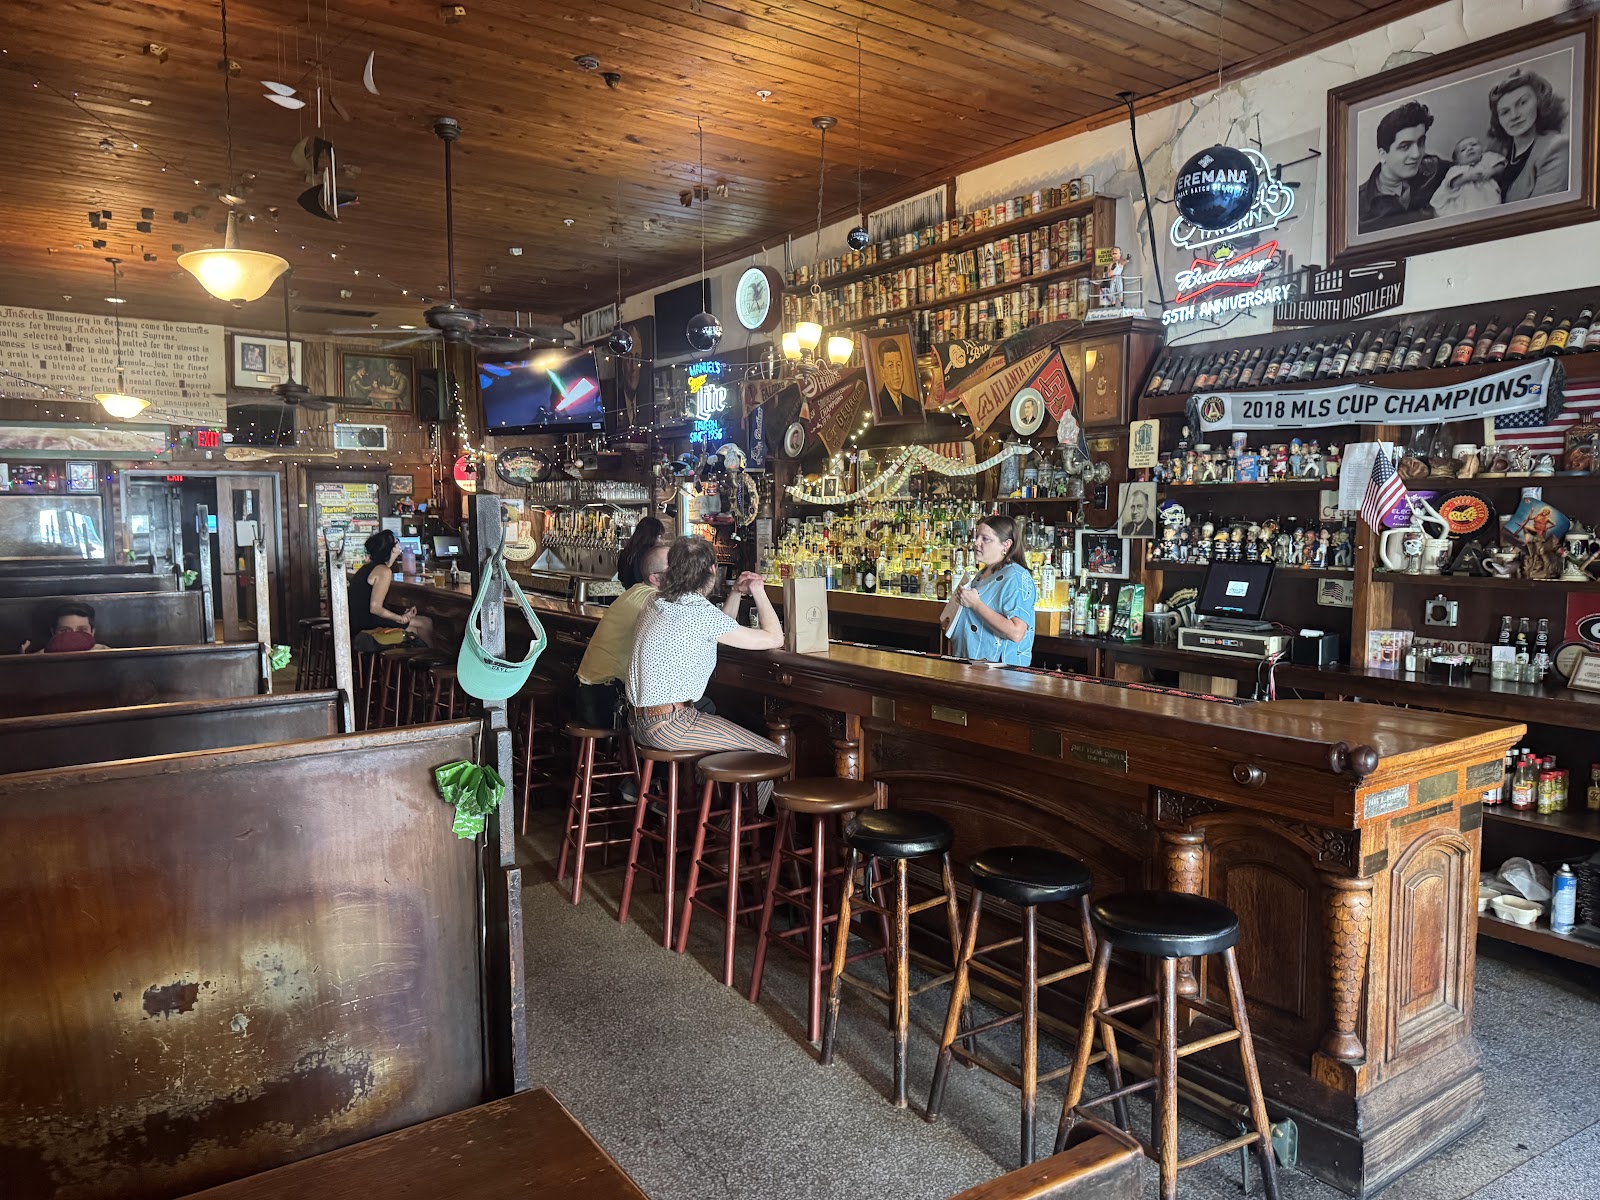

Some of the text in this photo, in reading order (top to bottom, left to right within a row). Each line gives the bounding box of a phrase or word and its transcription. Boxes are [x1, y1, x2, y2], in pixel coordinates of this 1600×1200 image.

[1177, 168, 1249, 190] EREMANA
[1175, 258, 1273, 291] Budweiser
[1161, 283, 1292, 326] 55TH ANNIVERSARY
[1276, 282, 1402, 321] OLD FOURTH DISTILLERY
[29, 321, 41, 330] for
[43, 322, 73, 334] brewing
[46, 312, 90, 326] Monastery
[93, 317, 101, 325] in
[163, 323, 174, 332] the
[23, 331, 59, 341] selected
[122, 339, 148, 348] malted
[150, 340, 161, 349] for
[163, 342, 174, 351] the
[7, 350, 29, 359] grain
[32, 351, 40, 359] is
[43, 353, 85, 362] contained
[90, 355, 98, 364] in
[100, 356, 114, 365] the
[172, 361, 185, 370] the
[187, 363, 209, 372] finest
[31, 341, 40, 350] is
[88, 346, 95, 354] to
[97, 346, 109, 355] old
[187, 354, 209, 362] other
[50, 373, 86, 383] provides
[91, 375, 104, 383] the
[51, 361, 76, 371] blend
[172, 370, 208, 380] imported
[688, 361, 722, 377] MANUEL'S
[990, 350, 1047, 408] ATLANTA FLAMES
[695, 383, 727, 421] Lite
[1243, 374, 1532, 419] 2018 MLS CUP CHAMPIONS
[694, 419, 719, 431] TAVERN
[708, 427, 723, 442] 1956
[197, 430, 220, 448] EXIT
[1453, 498, 1470, 506] SEED
[1457, 642, 1491, 657] Char
